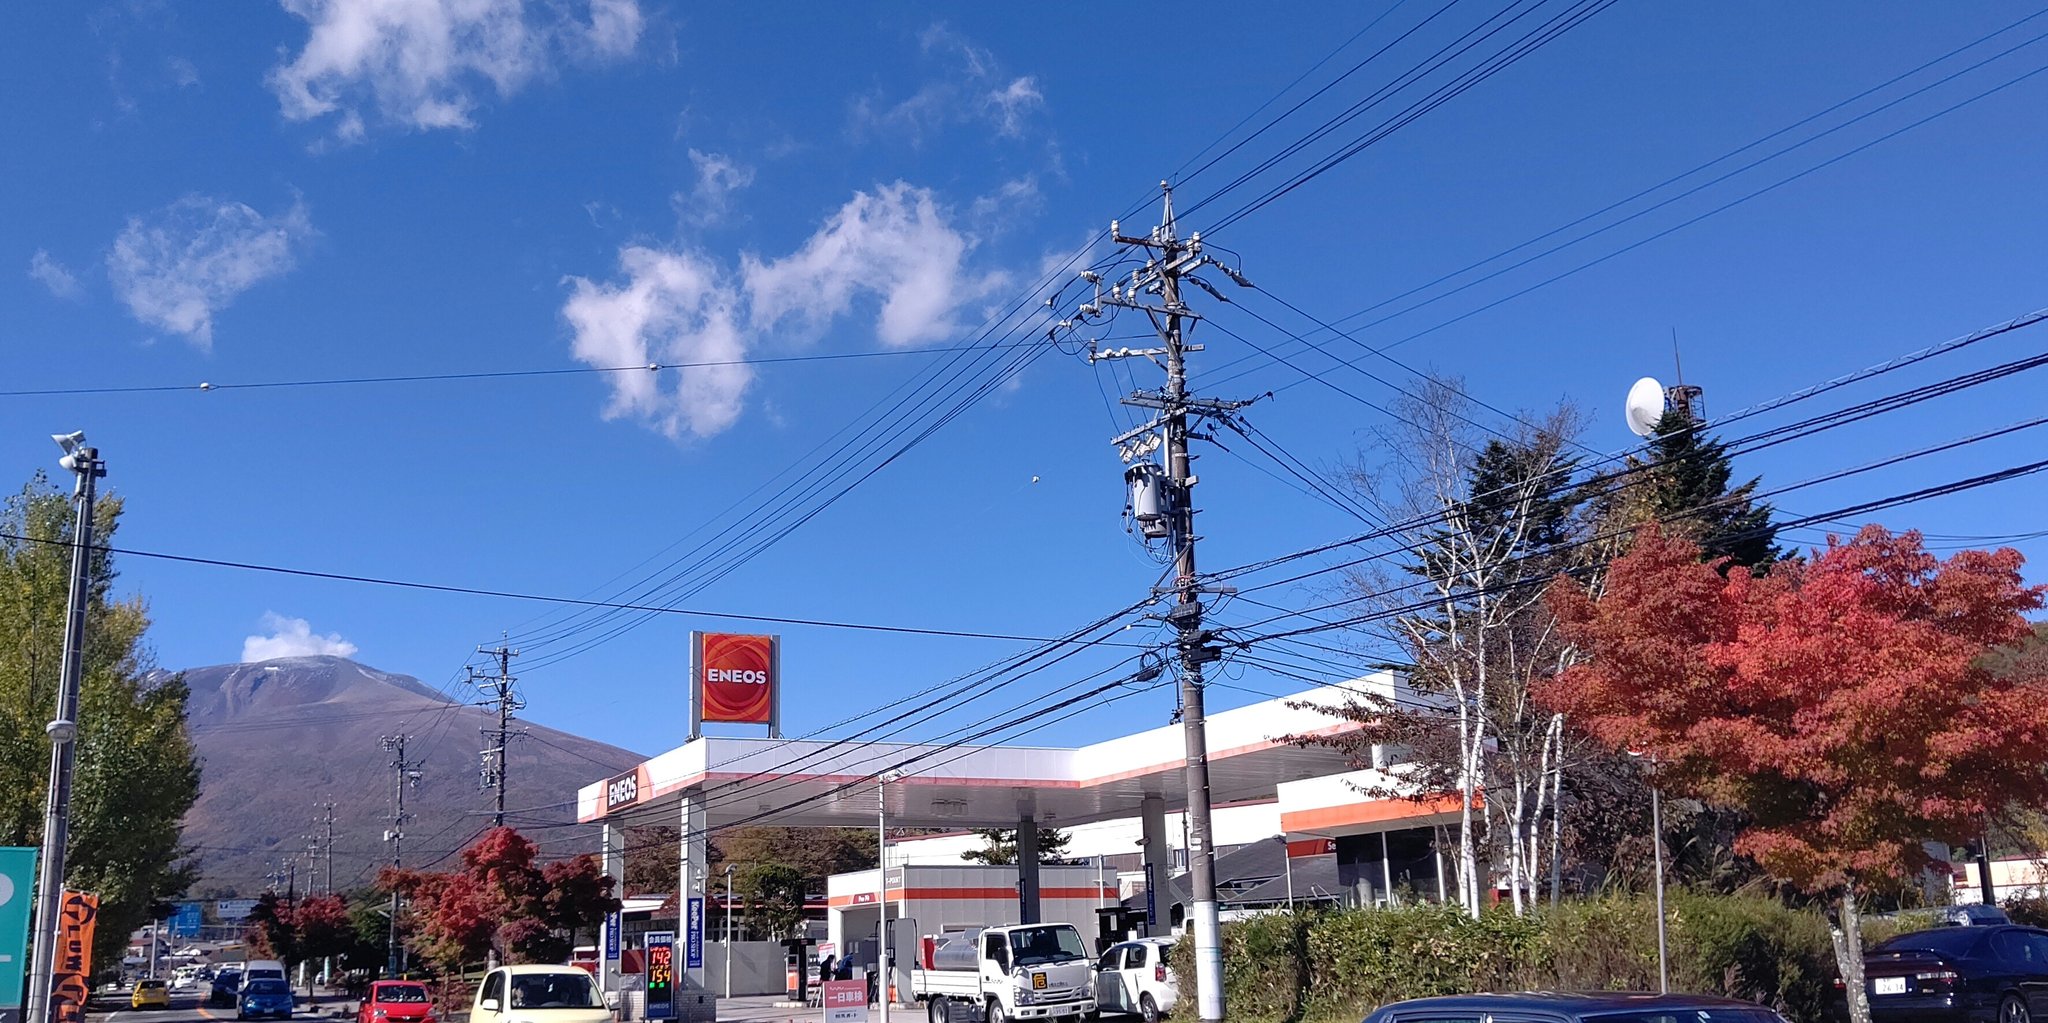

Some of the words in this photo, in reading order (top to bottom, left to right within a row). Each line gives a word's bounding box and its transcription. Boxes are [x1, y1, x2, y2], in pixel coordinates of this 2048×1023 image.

[707, 668, 767, 684] ENEOS
[608, 774, 637, 807] ENEOS
[690, 901, 700, 931] KeePer
[649, 936, 672, 944] 会員価格
[652, 951, 671, 965] 142
[652, 969, 671, 983] 154
[1033, 973, 1046, 989] 危
[828, 991, 863, 1003] 一日車検
